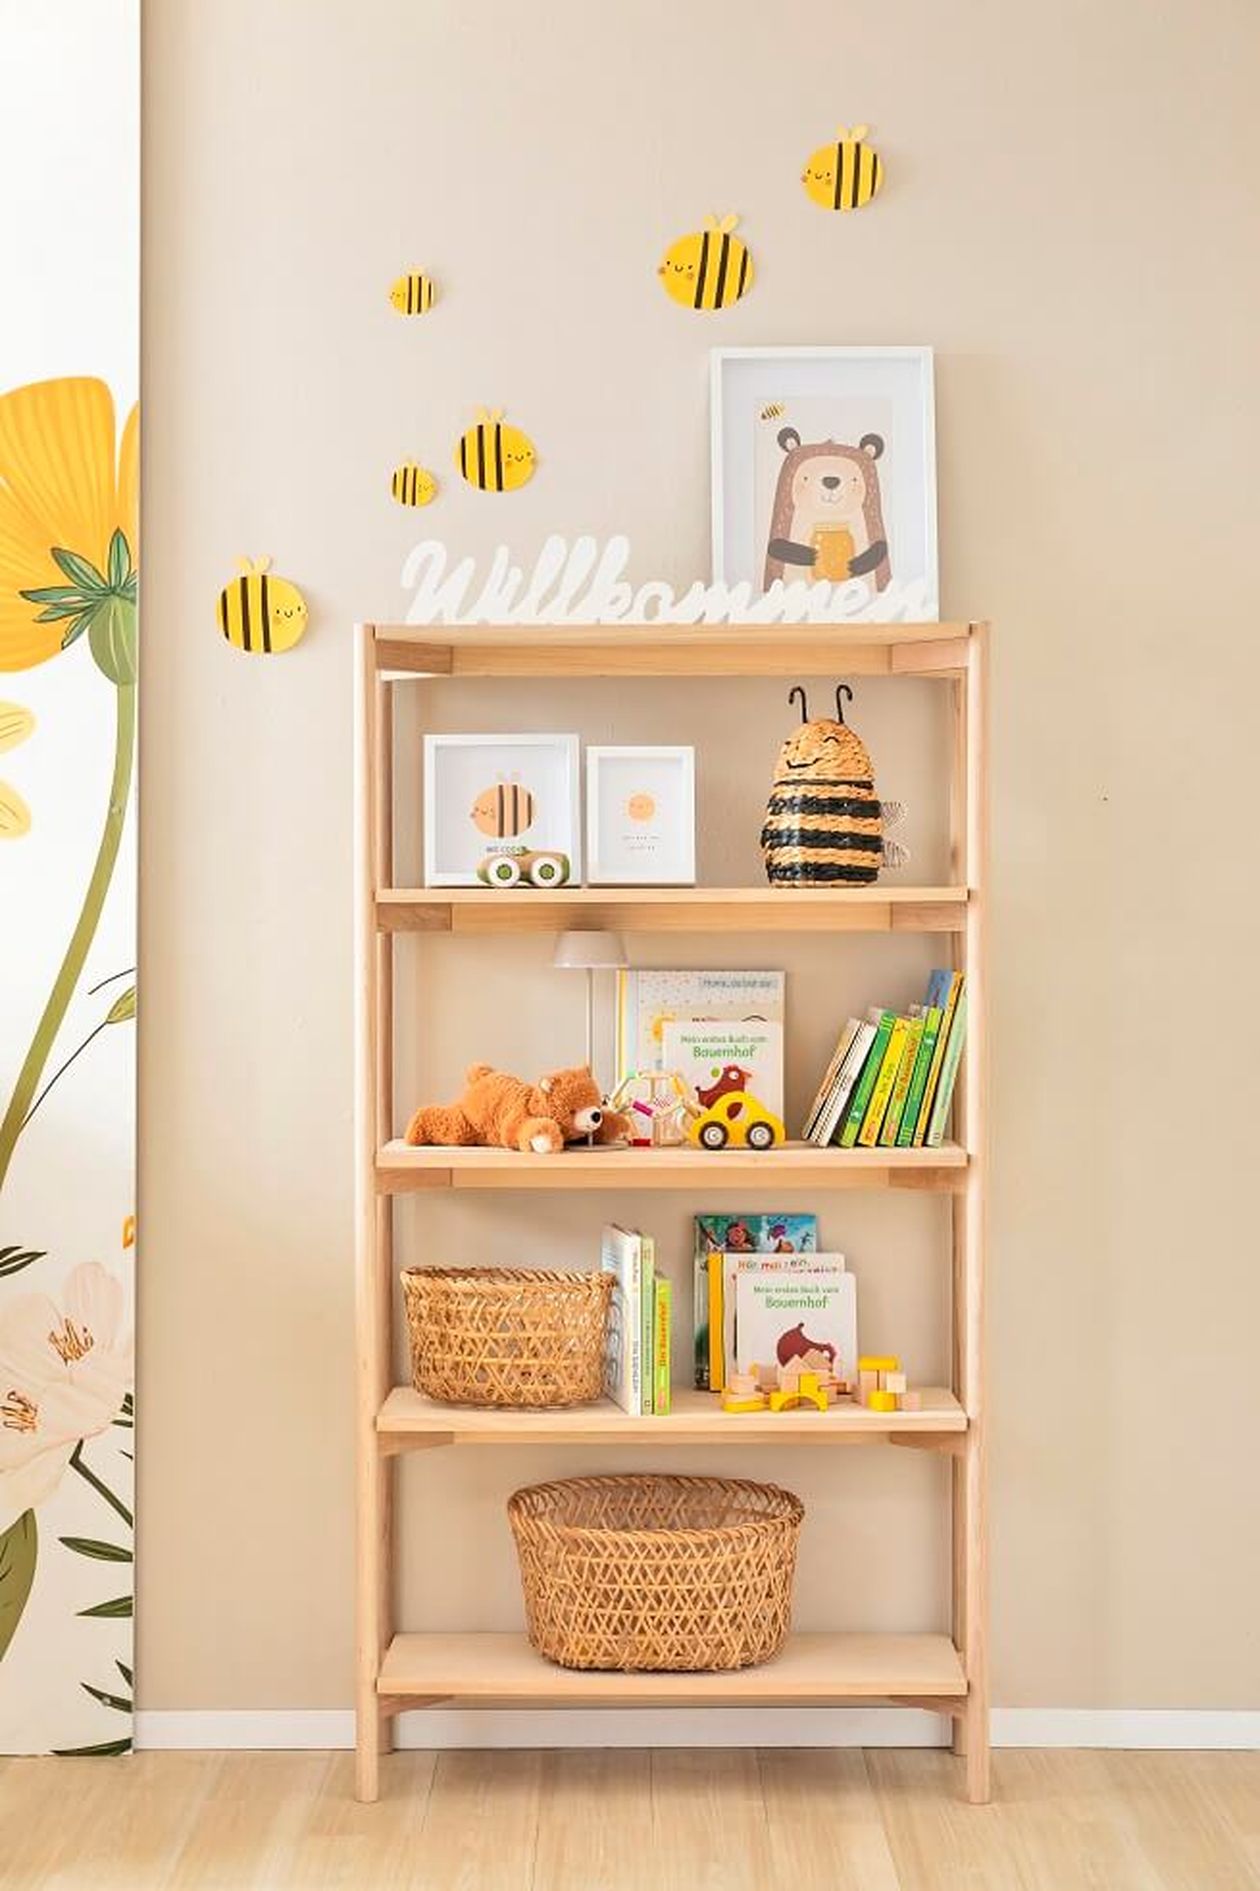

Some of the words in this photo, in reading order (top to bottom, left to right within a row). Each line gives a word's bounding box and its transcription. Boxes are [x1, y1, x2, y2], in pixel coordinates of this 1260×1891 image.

[401, 535, 936, 625] Willkommen
[693, 1044, 757, 1058] Bauernhof
[765, 1296, 828, 1309] Bauernhof
